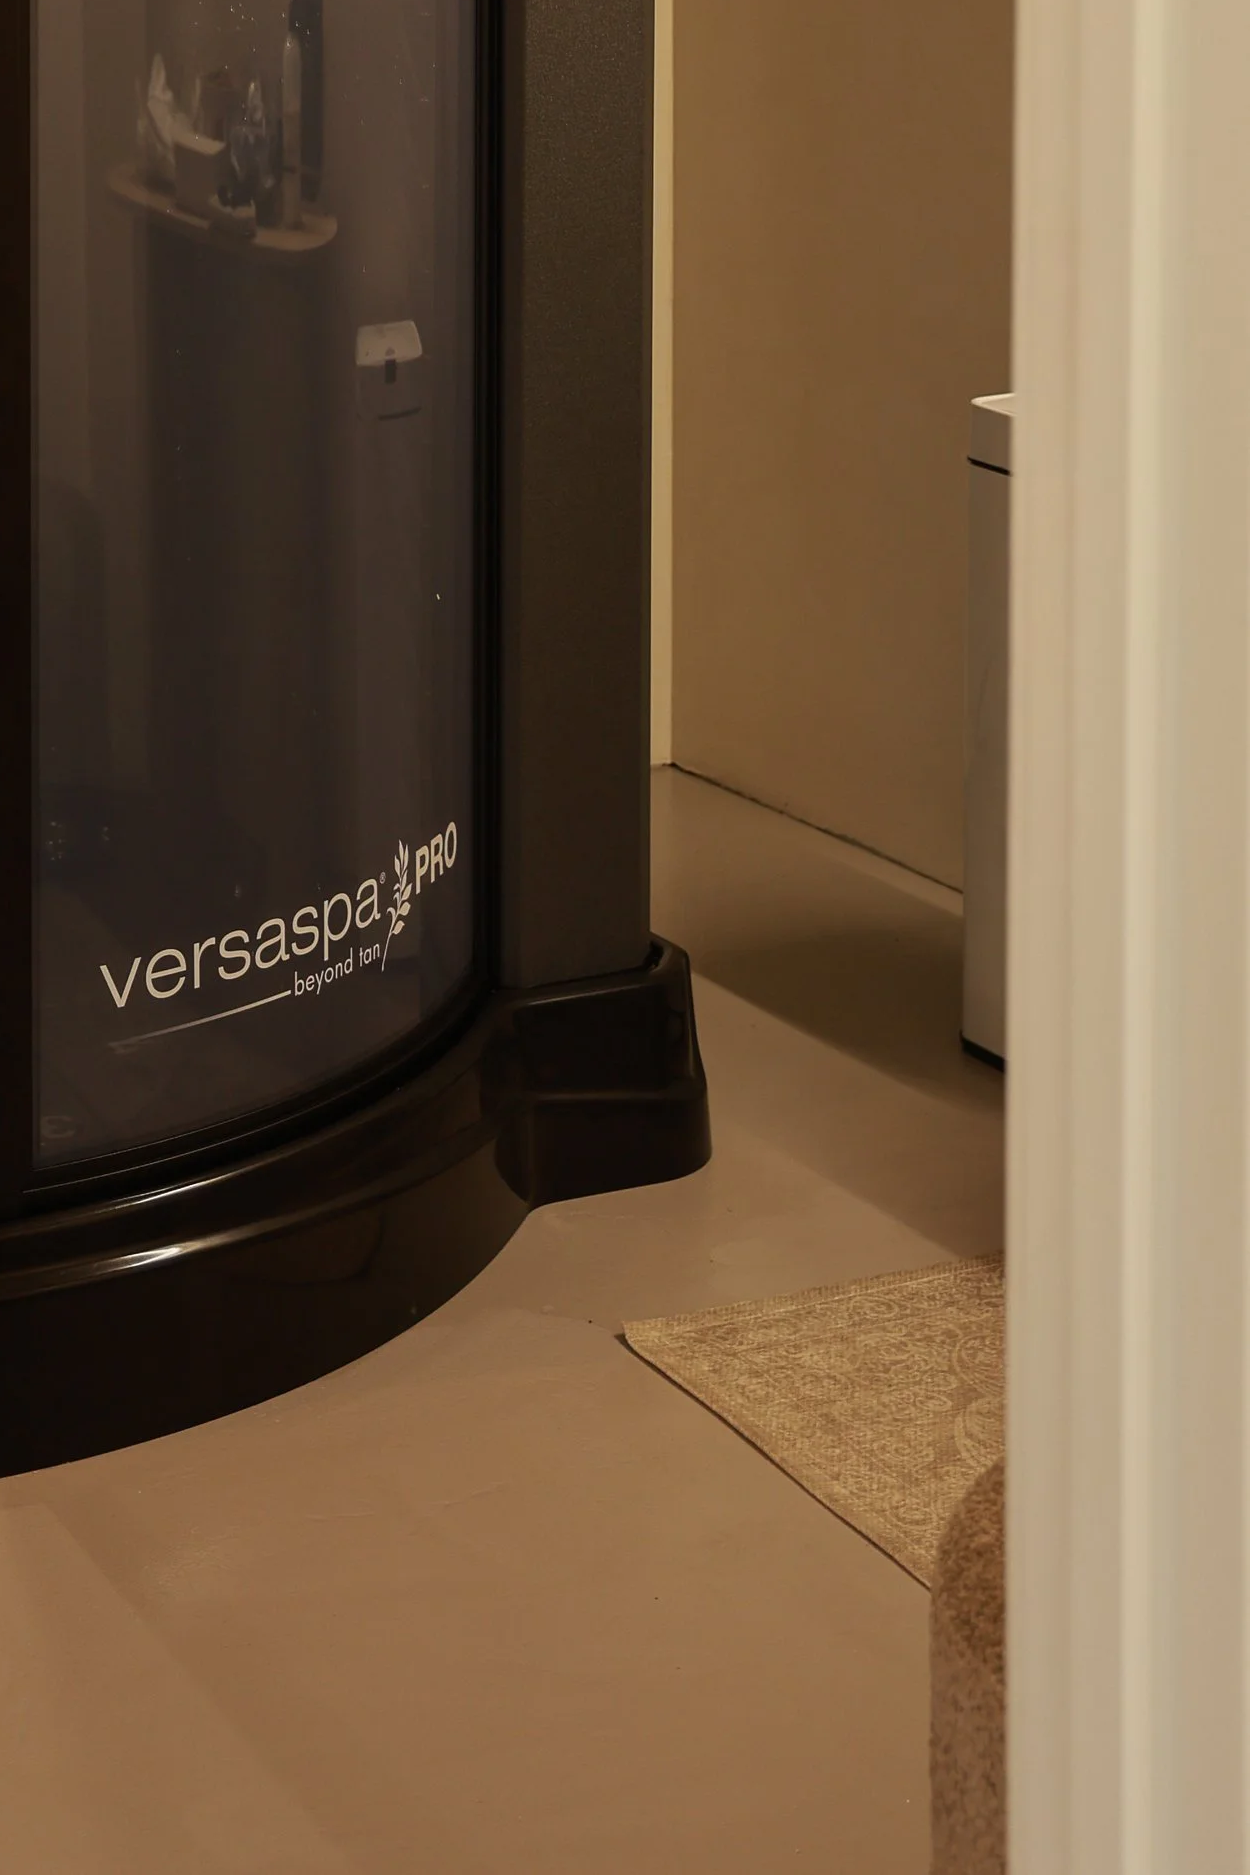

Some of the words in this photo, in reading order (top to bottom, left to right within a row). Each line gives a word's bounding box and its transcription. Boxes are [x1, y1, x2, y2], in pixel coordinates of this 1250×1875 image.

[415, 822, 458, 895] PRO
[294, 950, 354, 996] beyond
[358, 943, 381, 969] tan
